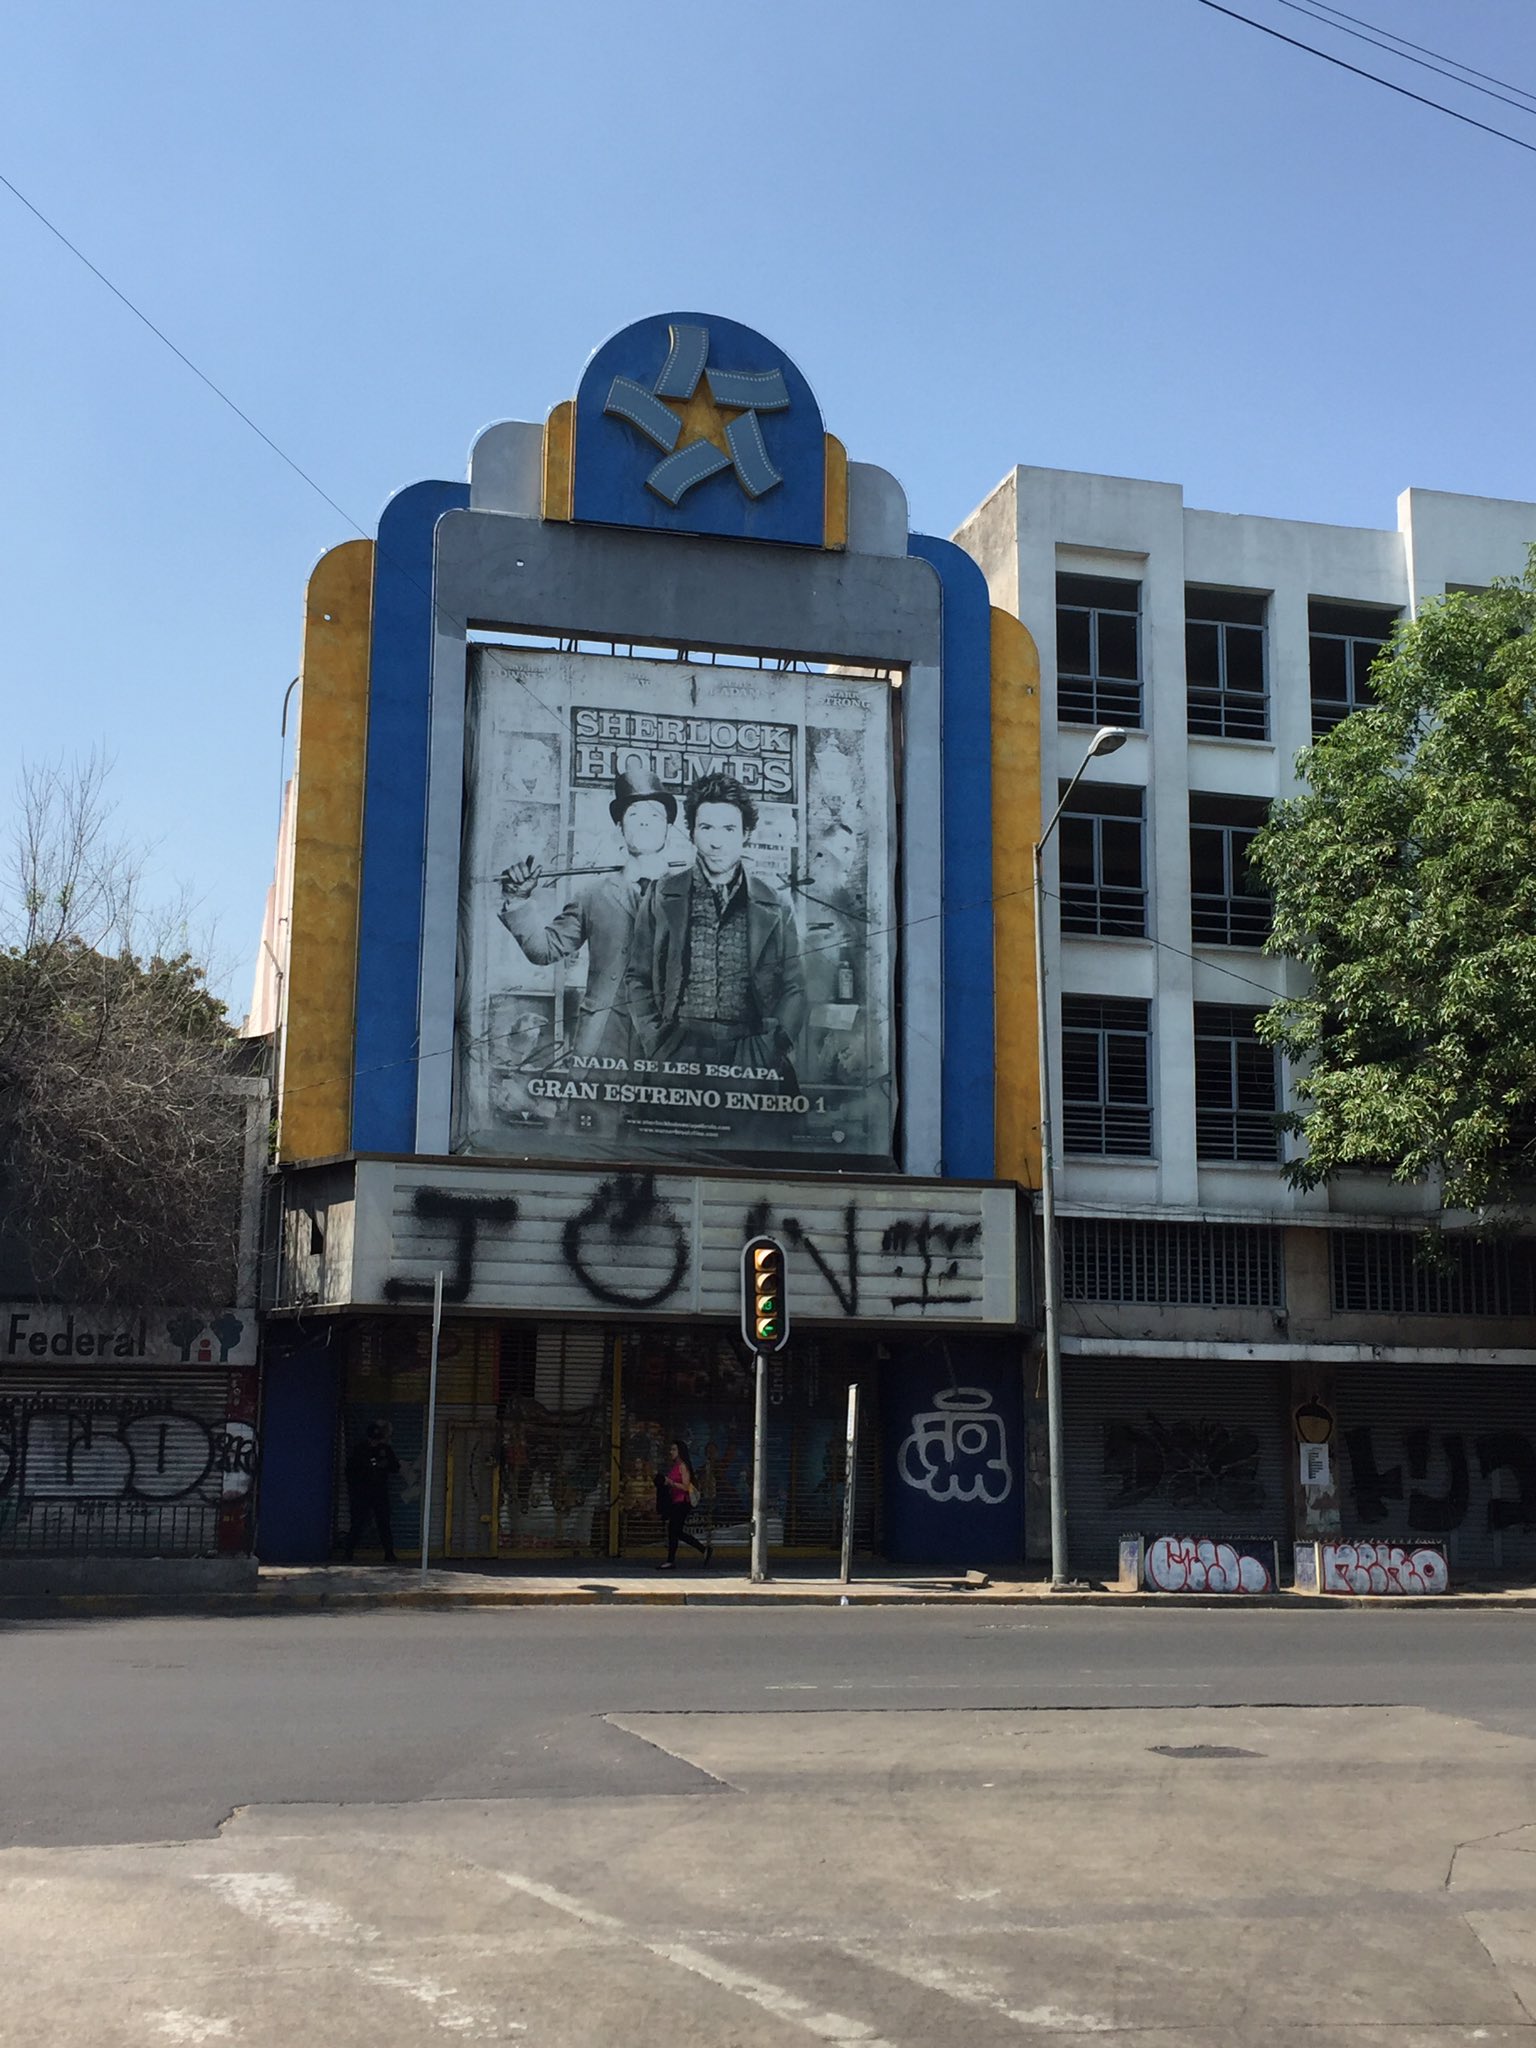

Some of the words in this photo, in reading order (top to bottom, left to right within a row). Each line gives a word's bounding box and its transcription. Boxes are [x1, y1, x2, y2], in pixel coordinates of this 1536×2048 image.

[576, 710, 791, 753] SHERLOCK
[576, 744, 793, 793] HOLMES
[572, 1055, 629, 1072] NADA
[633, 1059, 659, 1074] SE
[663, 1061, 701, 1077] LES
[705, 1063, 785, 1081] ESCAPA.
[527, 1078, 599, 1101] GRAN
[603, 1083, 722, 1109] ESTRENO
[725, 1091, 811, 1114] ENERO
[815, 1096, 826, 1113] 1
[8, 1313, 146, 1356] Federal
